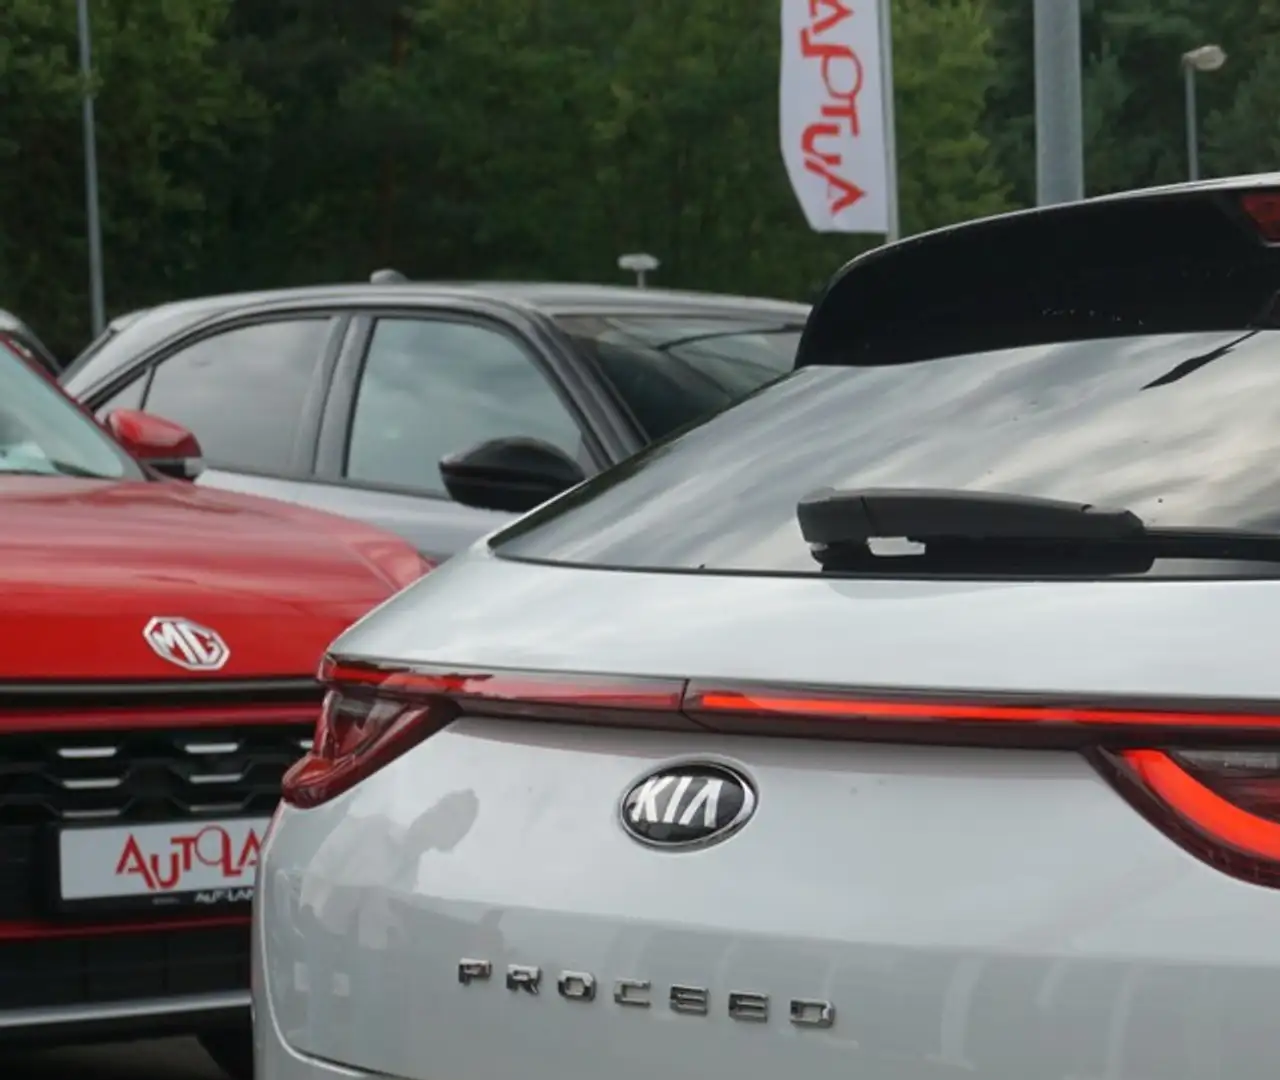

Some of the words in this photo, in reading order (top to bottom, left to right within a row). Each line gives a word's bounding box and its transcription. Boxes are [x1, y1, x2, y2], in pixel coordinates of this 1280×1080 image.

[150, 620, 224, 666] MG
[630, 775, 724, 828] KIA
[457, 957, 836, 1029] PROCEED
